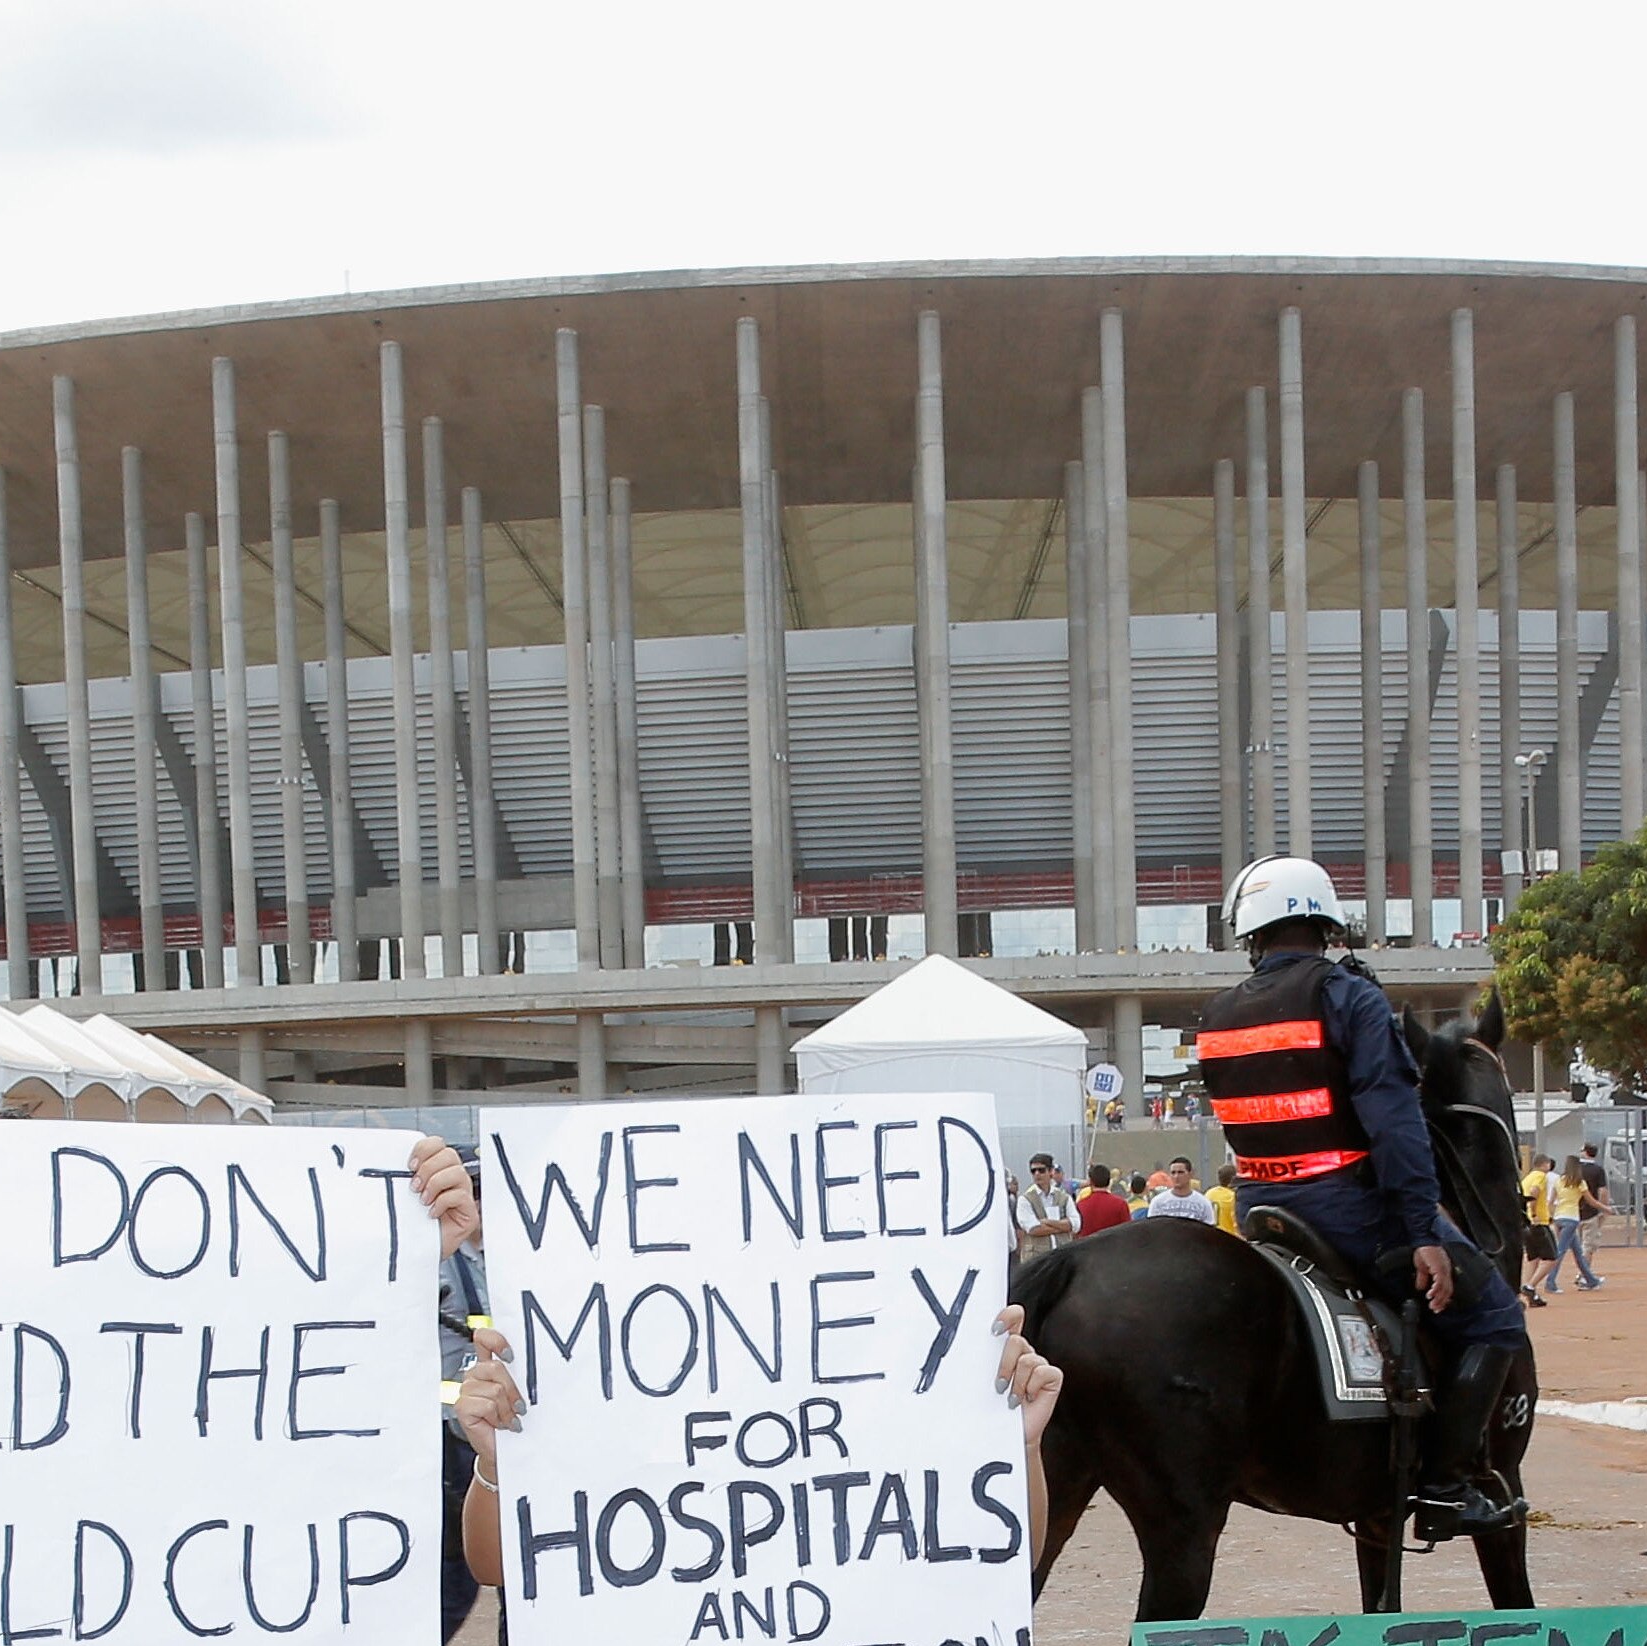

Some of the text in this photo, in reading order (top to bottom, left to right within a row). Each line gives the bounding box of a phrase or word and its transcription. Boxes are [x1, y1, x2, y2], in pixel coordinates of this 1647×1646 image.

[51, 1143, 416, 1284] DON'T
[492, 1116, 996, 1255] WE NEED
[100, 1321, 381, 1442] THE
[521, 1267, 981, 1406] MONEY
[685, 1398, 850, 1468] FOR
[164, 1510, 412, 1636] CUP
[516, 1460, 1023, 1600] HOSPITALS
[690, 1580, 832, 1643] AND
